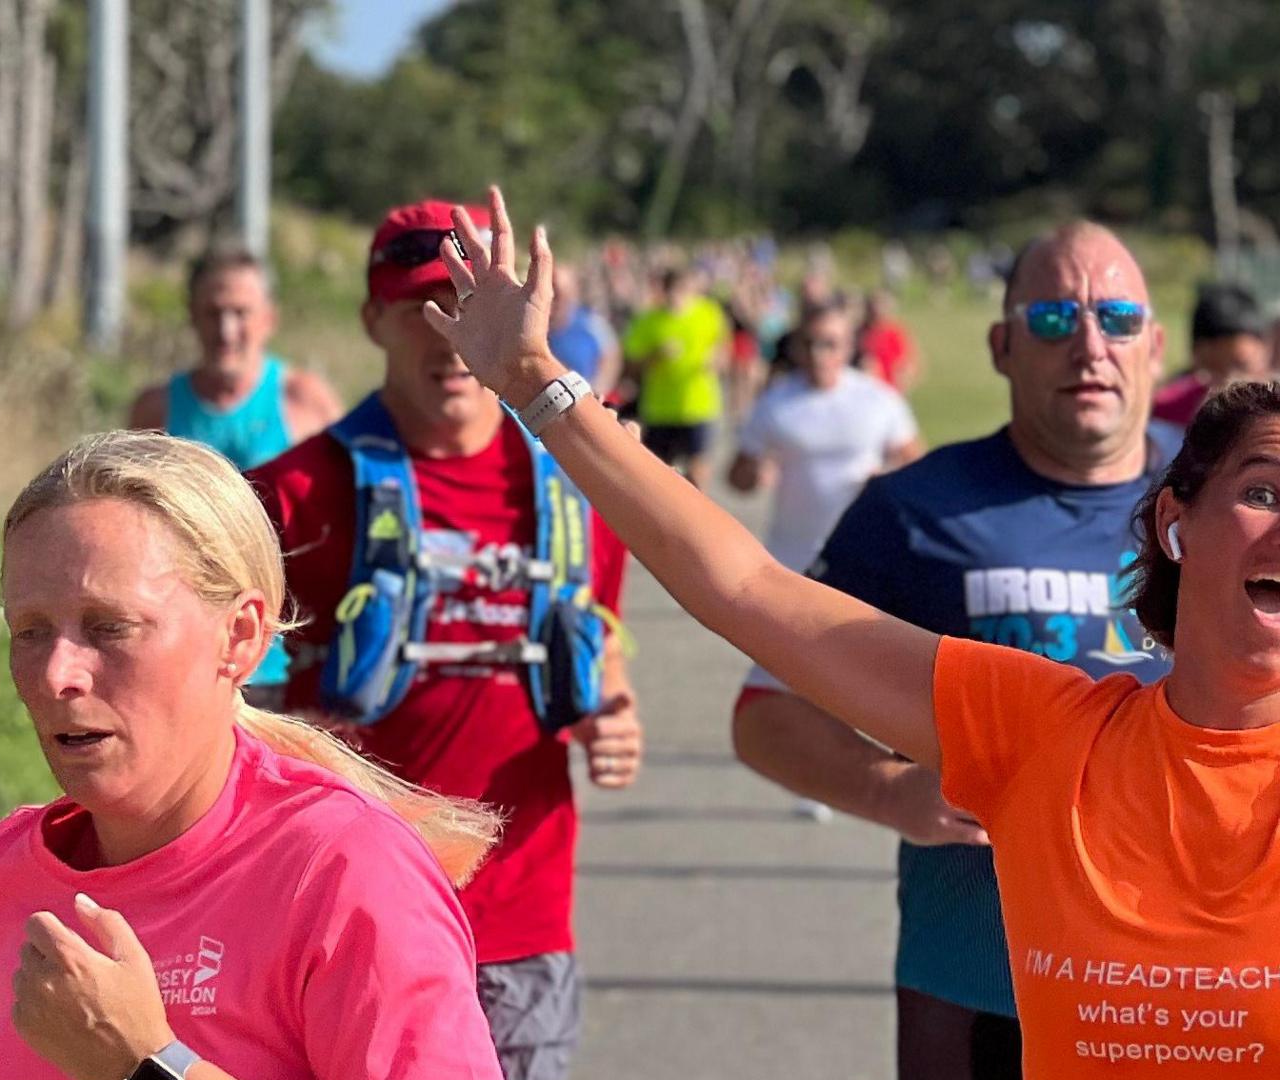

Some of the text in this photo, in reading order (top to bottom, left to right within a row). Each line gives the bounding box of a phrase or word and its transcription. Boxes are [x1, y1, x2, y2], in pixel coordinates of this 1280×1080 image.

[1026, 948, 1052, 976] I'M
[1055, 957, 1074, 980] A
[158, 968, 194, 987] SEY
[161, 986, 216, 1005] THLON
[1077, 1001, 1248, 1030] what's your
[1075, 1040, 1265, 1064] superpower?
